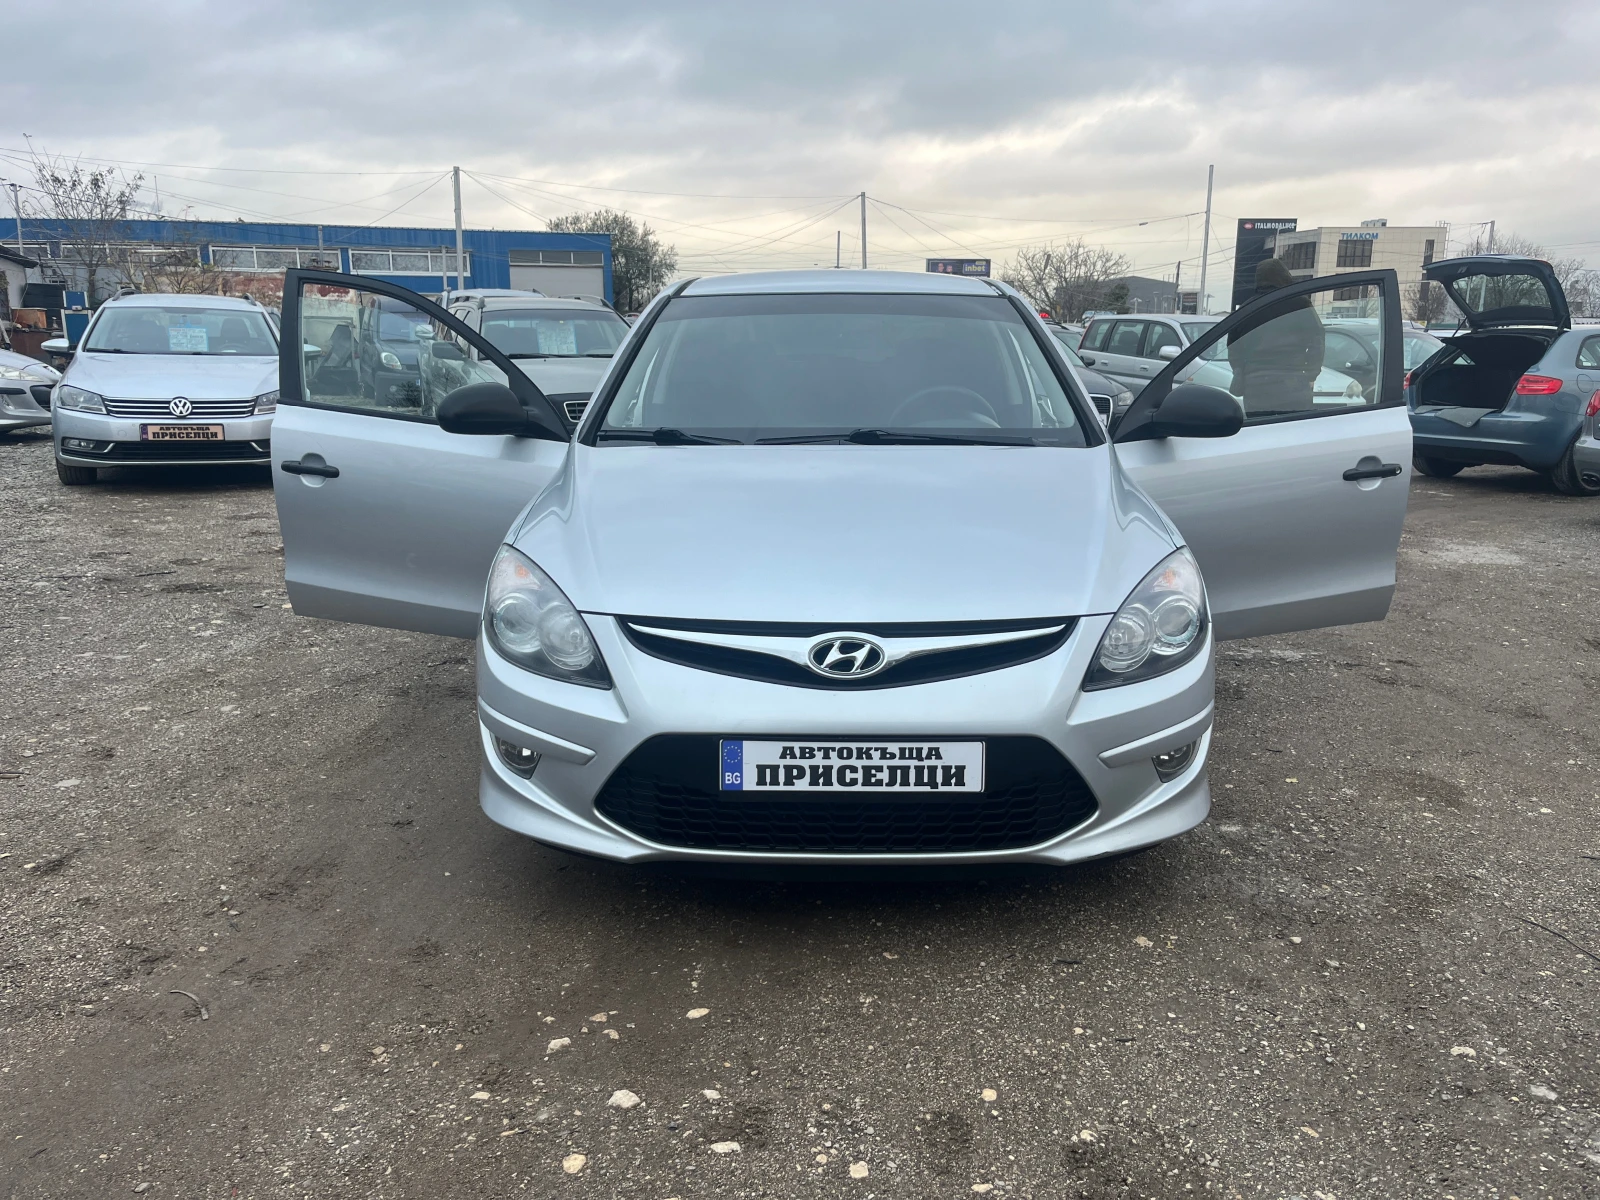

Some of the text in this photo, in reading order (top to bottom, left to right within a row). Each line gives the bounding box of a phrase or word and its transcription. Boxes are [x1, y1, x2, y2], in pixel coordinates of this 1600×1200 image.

[1341, 232, 1378, 240] ТИЛКОМ
[779, 746, 943, 761] АВТОКЪЩА
[725, 772, 741, 784] BG
[755, 764, 966, 789] ПРИСЕЛЦИ
